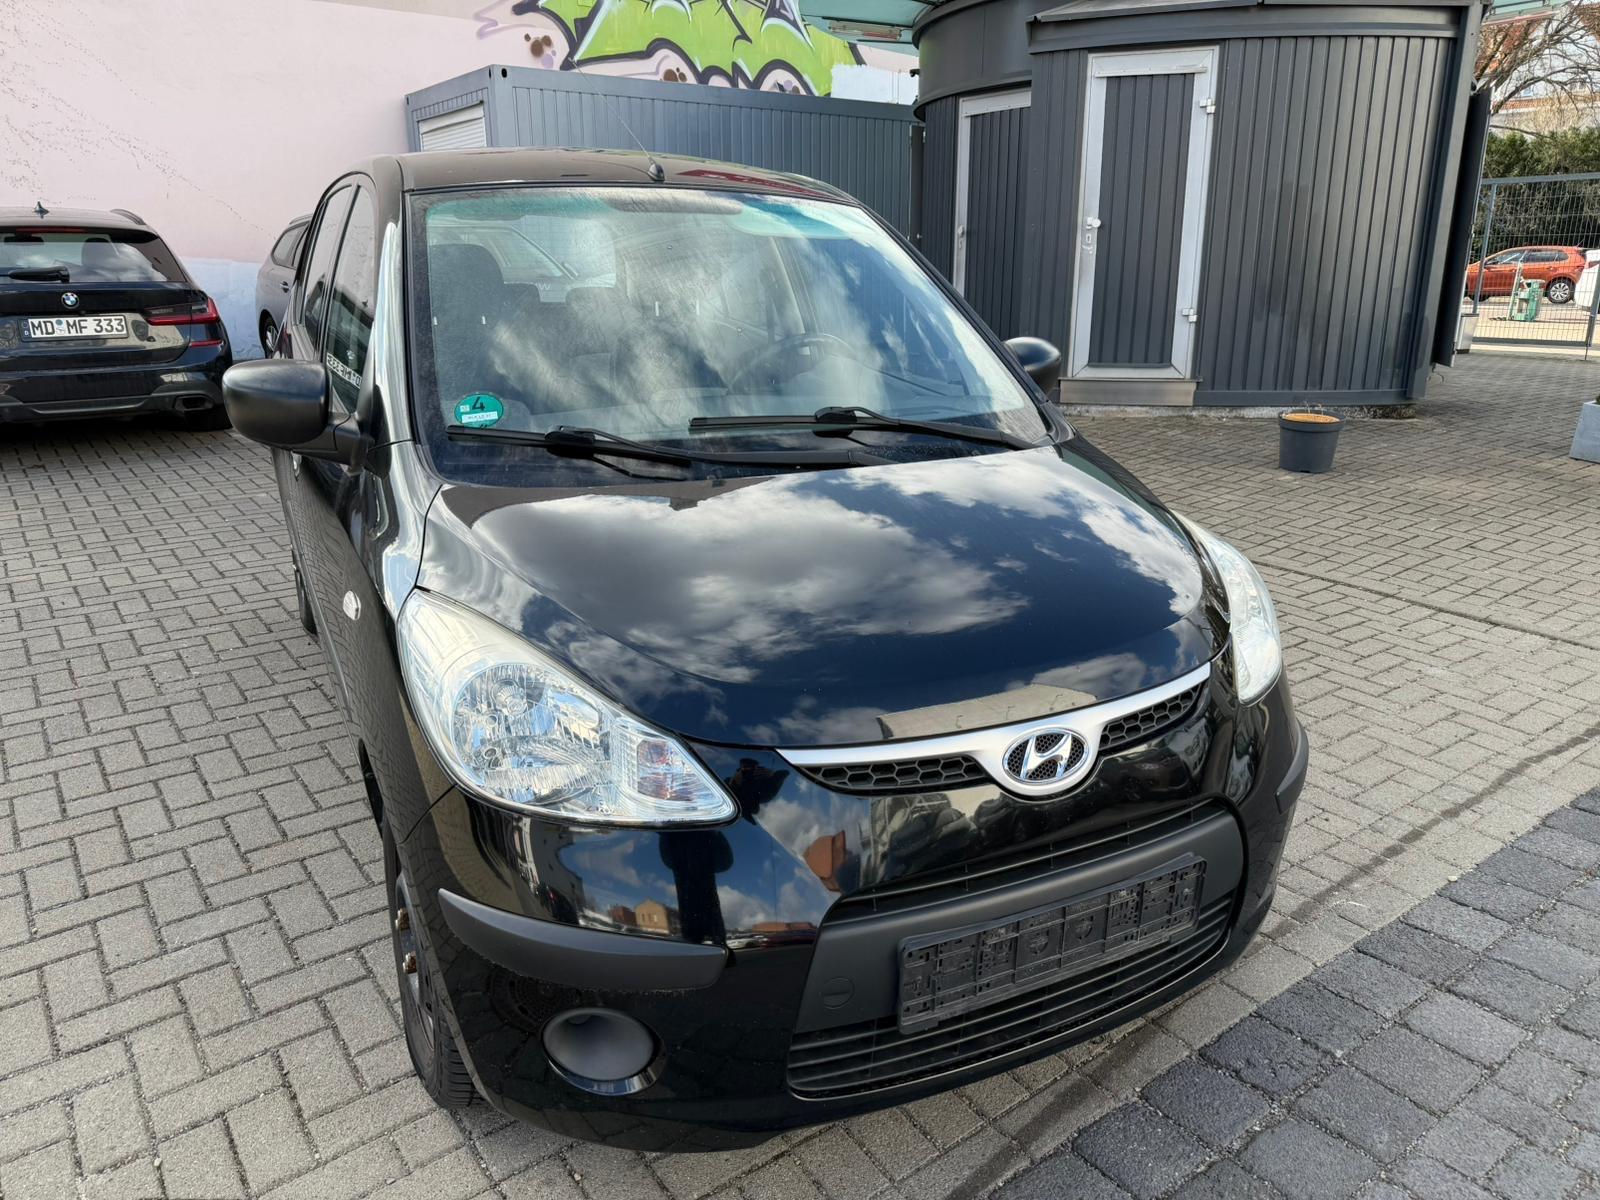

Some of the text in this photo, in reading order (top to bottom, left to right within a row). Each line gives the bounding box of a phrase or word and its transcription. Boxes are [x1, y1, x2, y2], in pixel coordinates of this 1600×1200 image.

[30, 318, 125, 336] MD MF 333
[472, 396, 485, 411] 4
